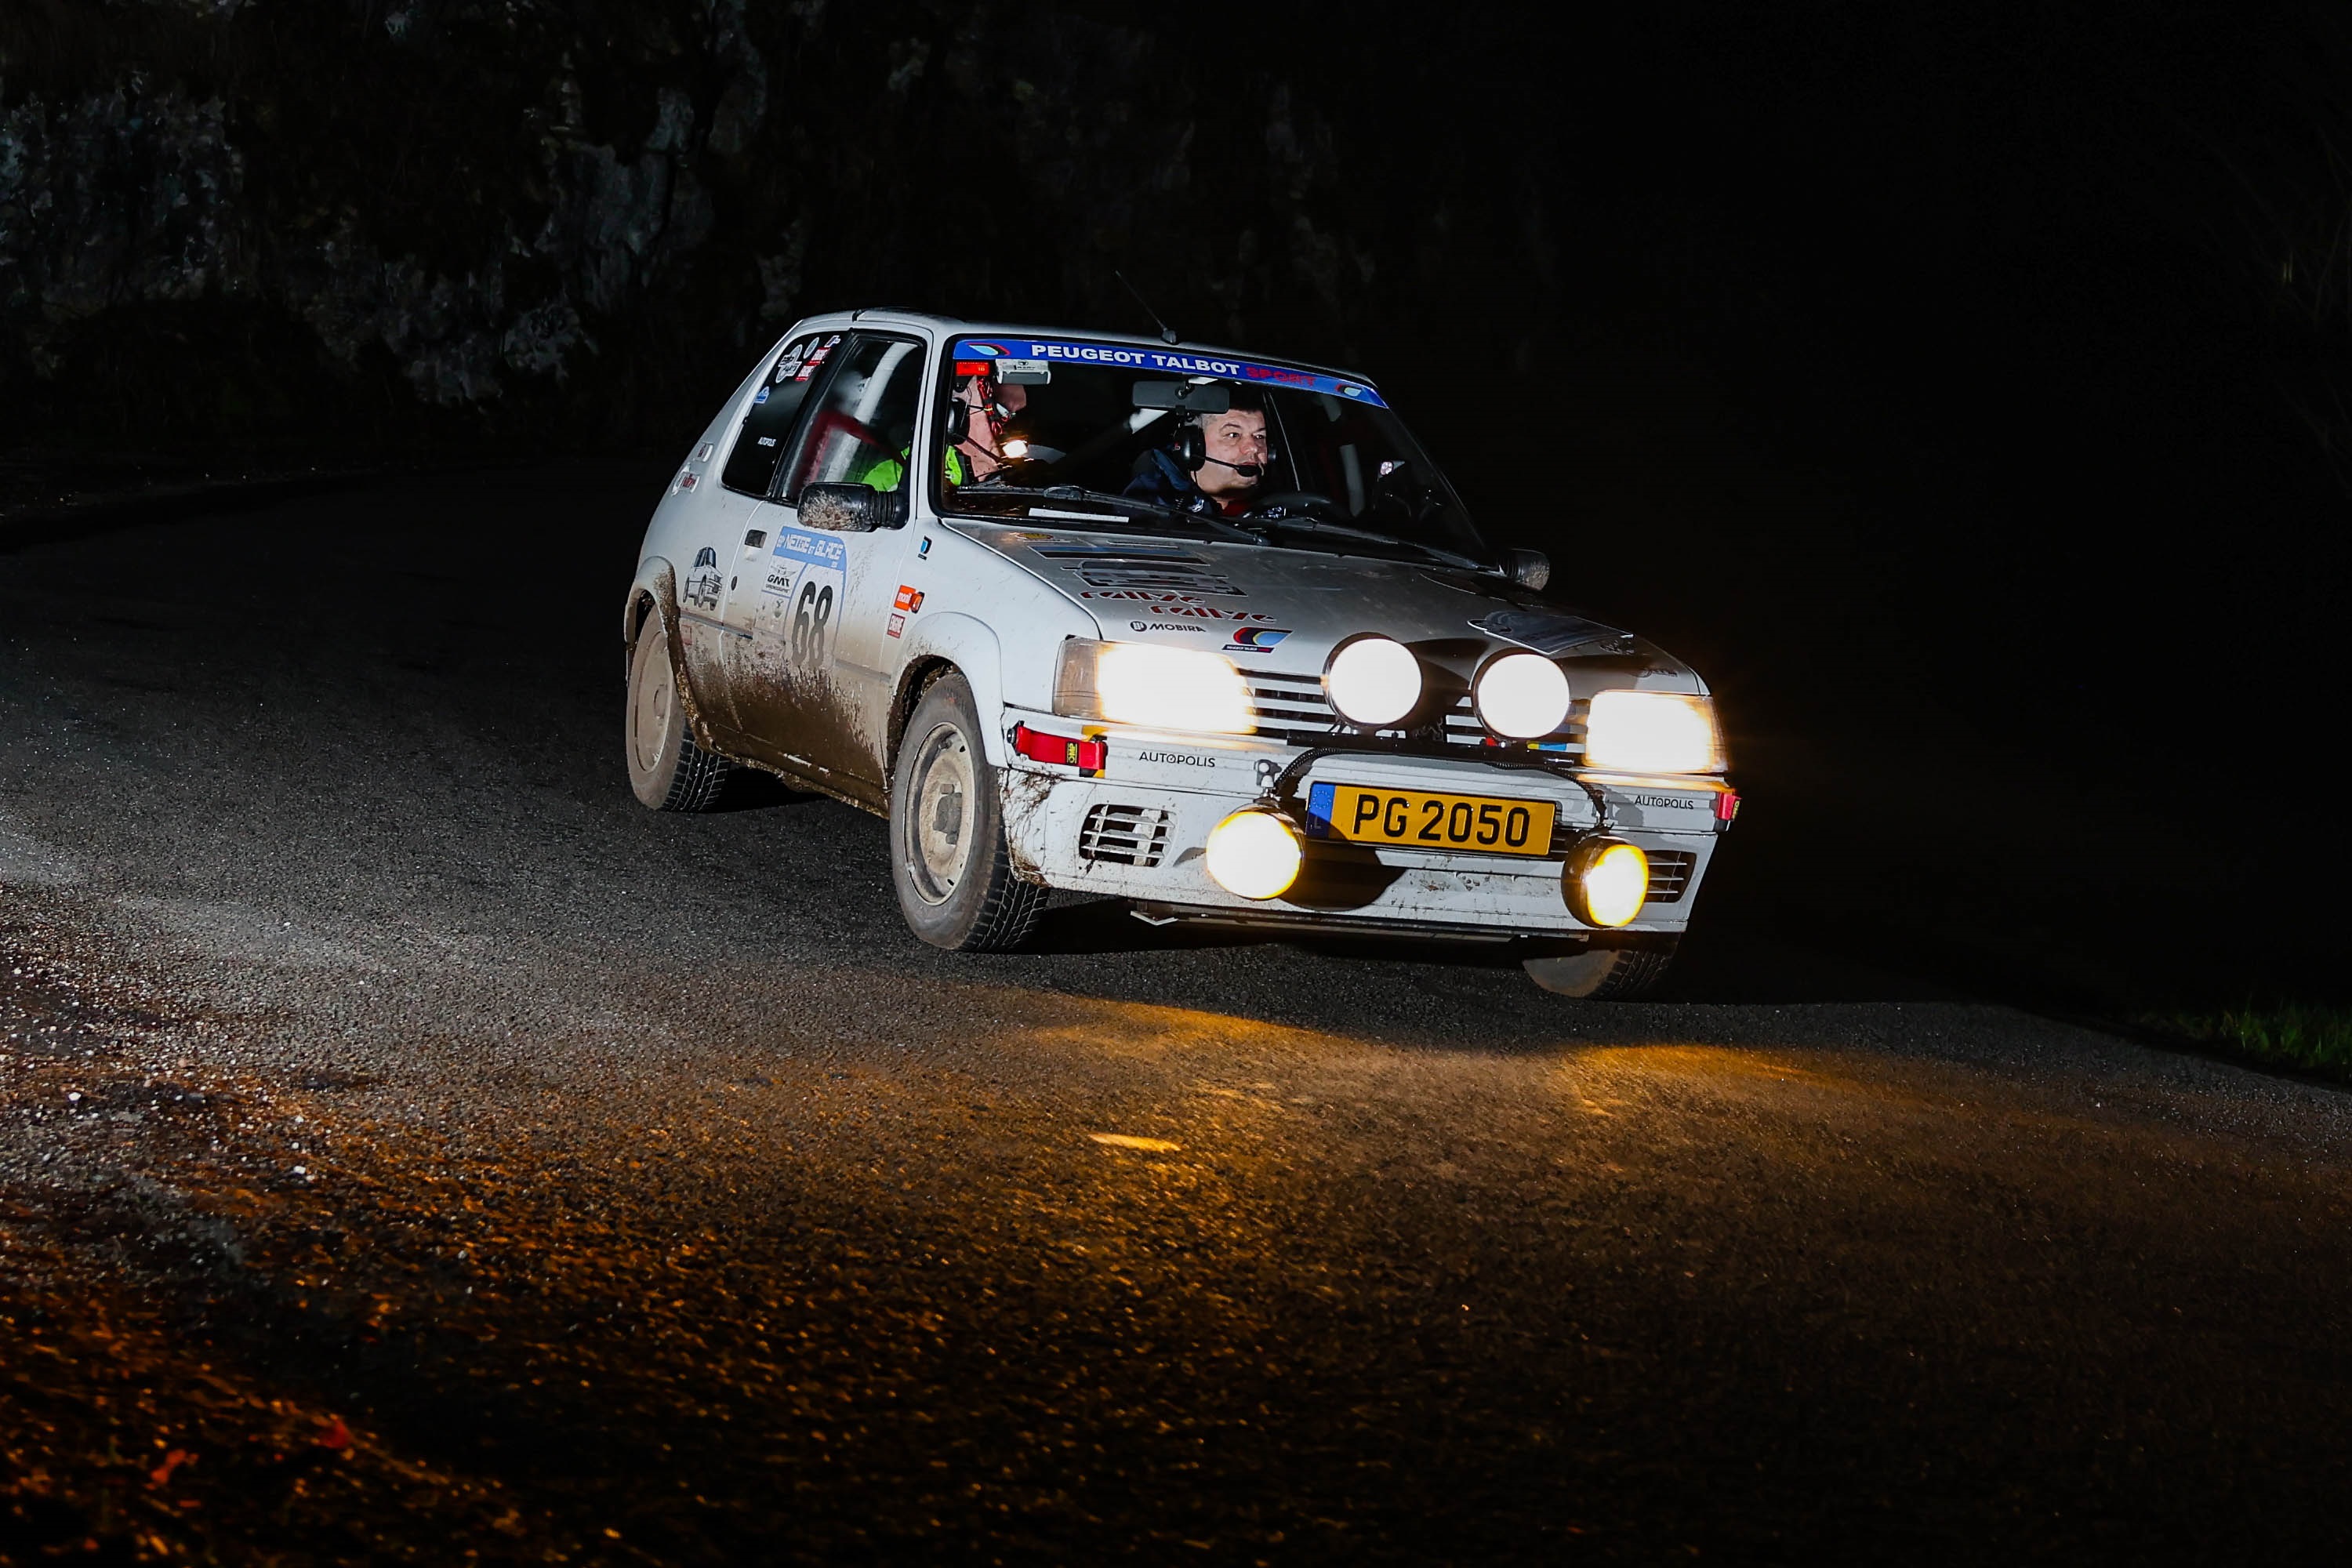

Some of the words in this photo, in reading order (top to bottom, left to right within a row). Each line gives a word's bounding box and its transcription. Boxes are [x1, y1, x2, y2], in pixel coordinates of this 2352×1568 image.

[1031, 344, 1145, 365] PEUGEOT
[1151, 354, 1240, 375] TALBOT
[1246, 366, 1316, 386] SPORT
[814, 539, 844, 561] GLACE
[767, 574, 790, 587] GMT
[1080, 590, 1206, 604] rallye
[1149, 605, 1277, 623] rallye
[792, 581, 833, 667] 68
[1149, 622, 1207, 633] MOBIRA
[1138, 751, 1216, 768] AUTOPOLIS
[1635, 795, 1694, 810] AUTOPOLIS
[1352, 793, 1410, 838] PG
[1417, 800, 1530, 848] 2050
